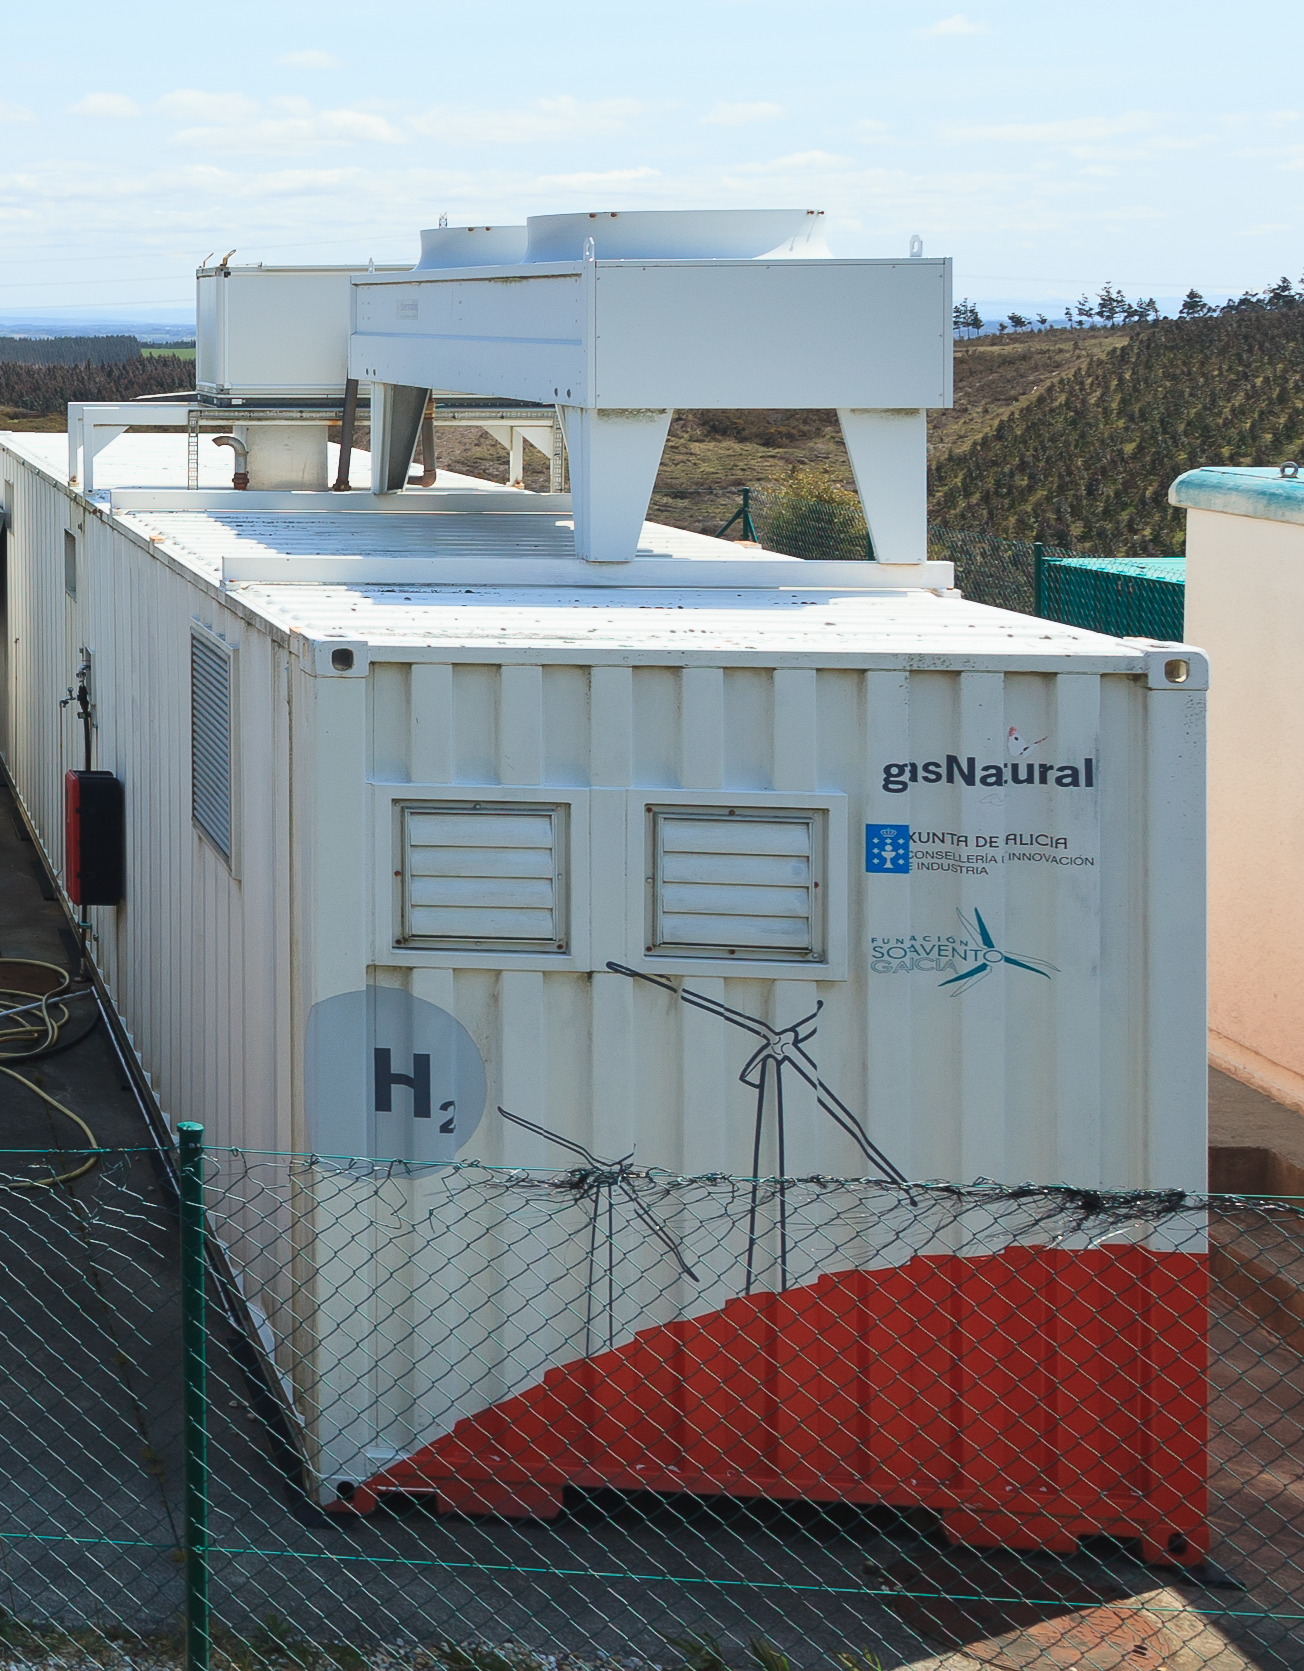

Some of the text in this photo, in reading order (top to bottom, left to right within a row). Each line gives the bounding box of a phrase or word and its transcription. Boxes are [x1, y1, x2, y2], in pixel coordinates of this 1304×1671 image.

[908, 831, 968, 848] XUNTA
[975, 835, 999, 848] DE
[1008, 851, 1095, 866] INNOVACIÓN
[917, 861, 989, 876] INDUSTRIA
